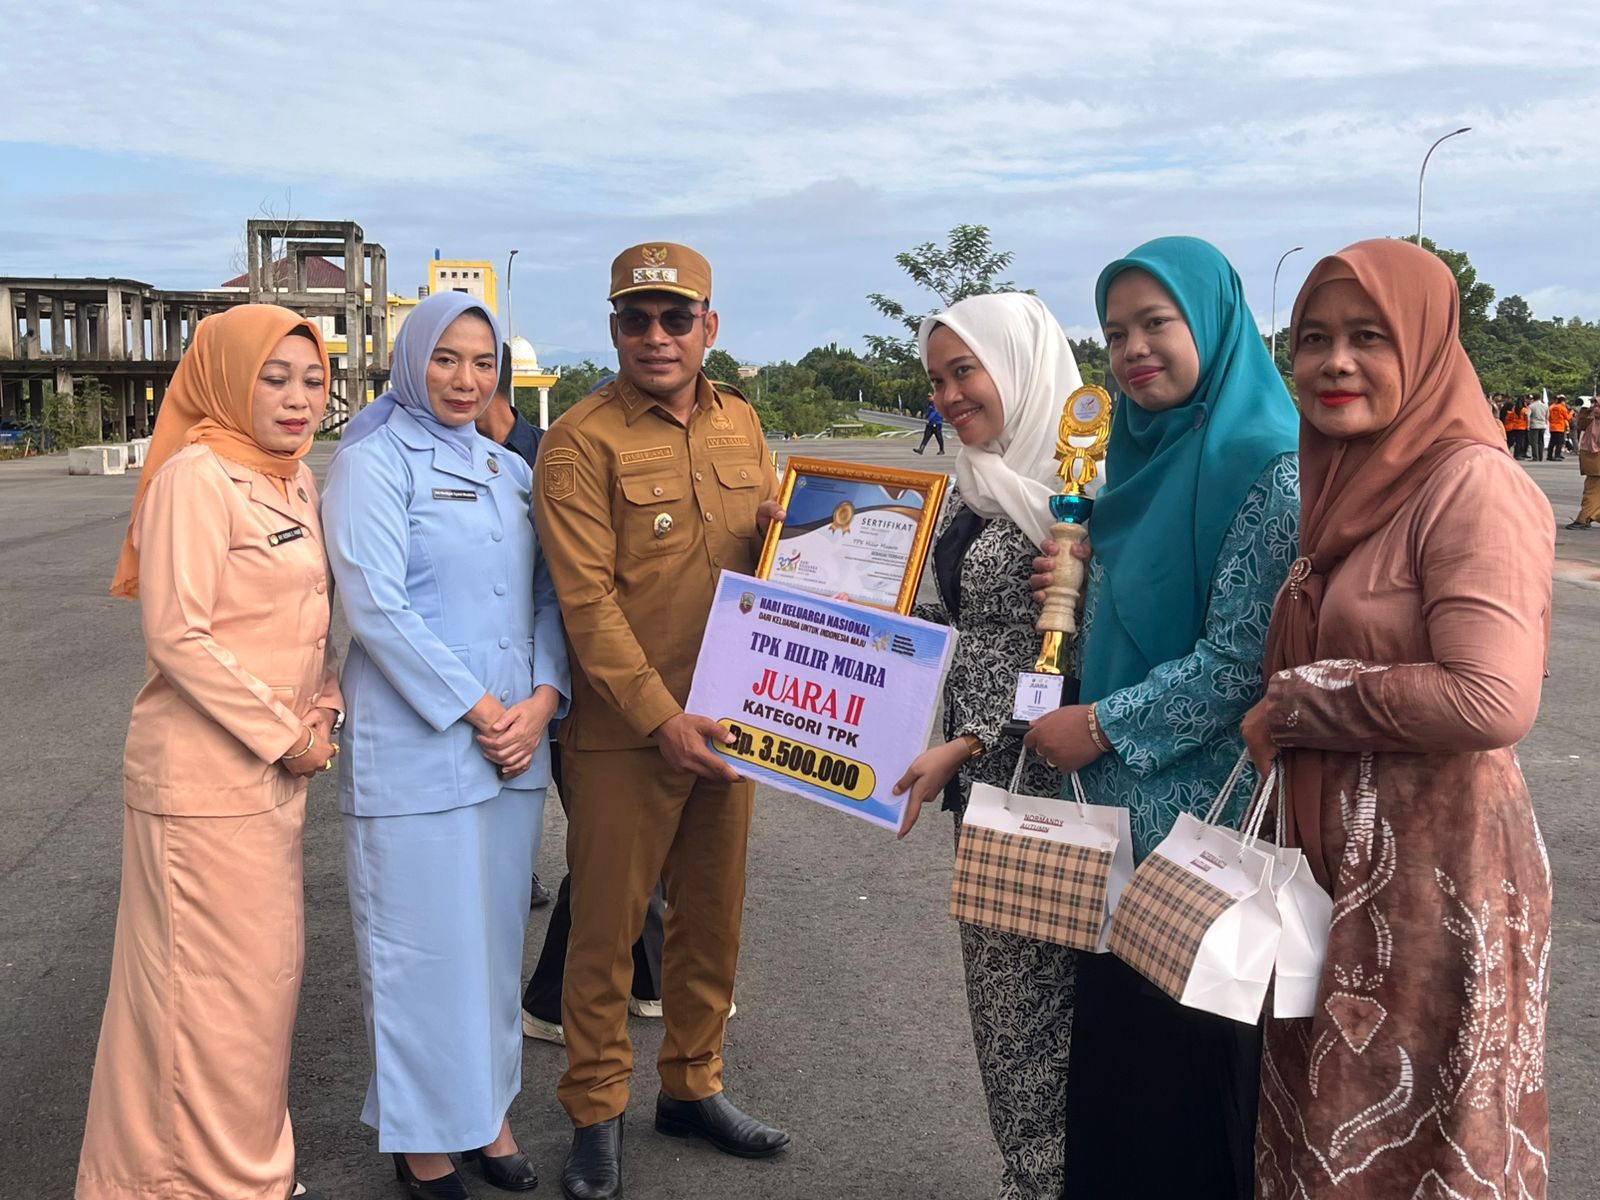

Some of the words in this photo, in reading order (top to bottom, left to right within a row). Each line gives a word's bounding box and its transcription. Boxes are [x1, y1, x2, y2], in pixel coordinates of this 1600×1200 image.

[861, 517, 913, 532] SERTIFIKAT
[758, 612, 772, 622] DARI
[772, 616, 800, 629] KELUARGA
[800, 623, 820, 635] UNTUK
[820, 628, 849, 644] INDONESIA
[850, 637, 867, 647] MAJU
[760, 598, 781, 613] HARI
[781, 603, 826, 625] KELUARGA
[826, 614, 871, 637] NASIONAL
[750, 631, 782, 657] TPK
[784, 641, 829, 671] HILIR
[831, 654, 886, 688] MUARA
[752, 668, 838, 720] JUARA
[845, 694, 866, 727] II
[742, 699, 822, 735] KATEGORI
[827, 725, 860, 748] TPK
[726, 723, 755, 757] Rp.
[758, 735, 860, 791] 3.500.000
[1024, 814, 1064, 827] NORMANDY
